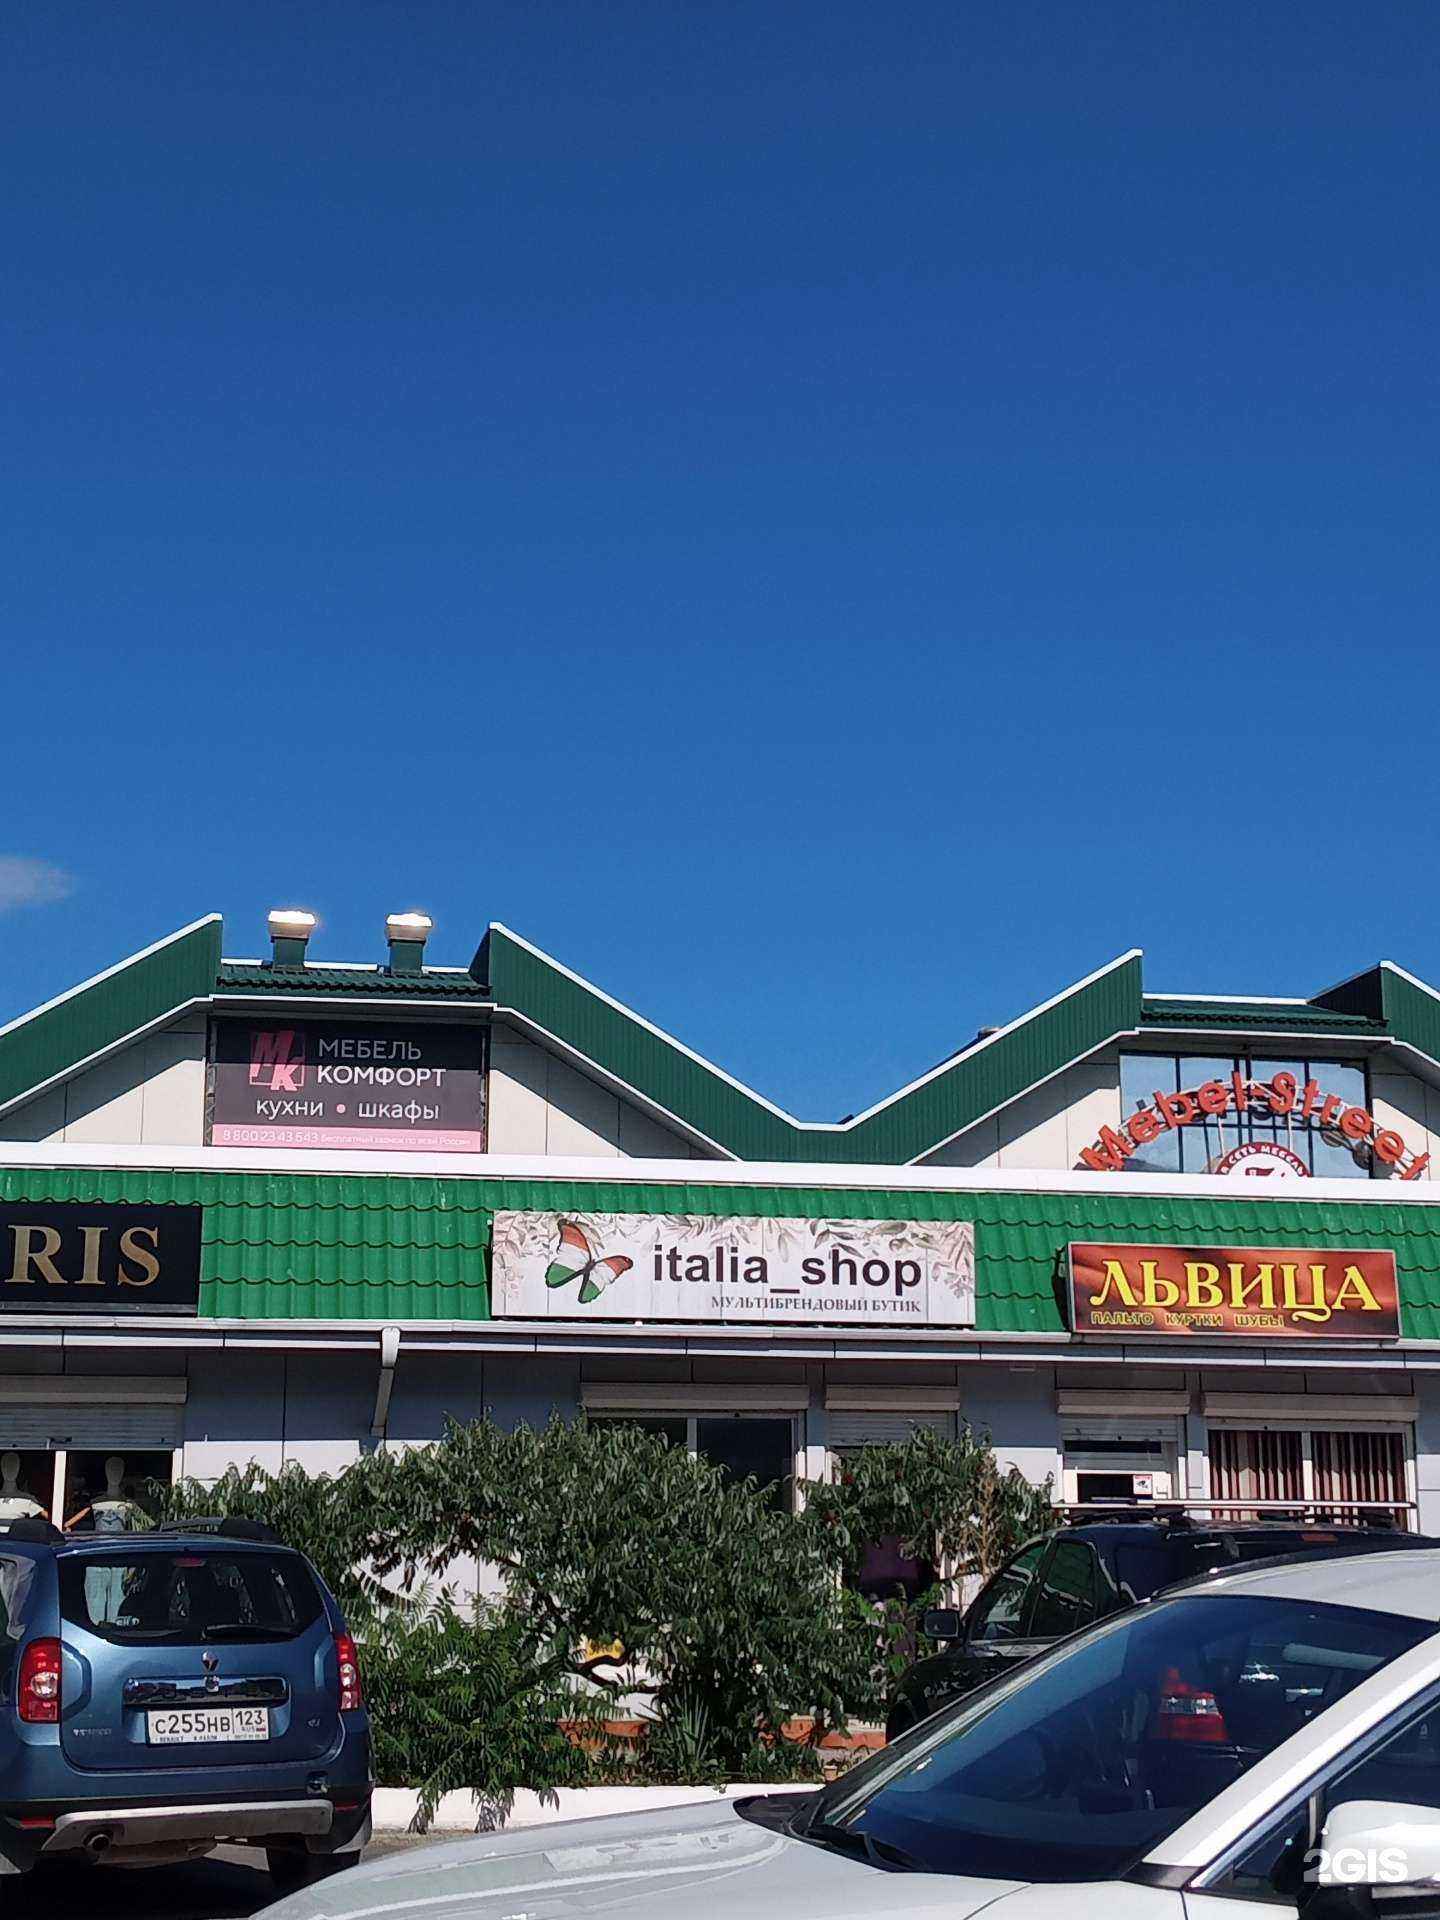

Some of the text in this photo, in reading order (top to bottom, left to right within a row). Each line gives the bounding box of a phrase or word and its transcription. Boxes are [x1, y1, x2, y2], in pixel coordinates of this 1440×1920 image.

[318, 1038, 422, 1060] МЕБЕЛЬ
[317, 1065, 446, 1087] КОМФОРТ
[256, 1099, 439, 1124] кухни шкафы
[4, 1225, 160, 1287] RIS
[653, 1244, 922, 1297] italia_shop
[1089, 1259, 1382, 1322] ЛЬВИЦА
[711, 1295, 921, 1313] МУЛЬТИБРЕНДОВЫЙ БУТИК
[1090, 1311, 1286, 1328] ПАЛЬТО КУРТКИ ШУБЫ
[235, 1710, 262, 1726] 123
